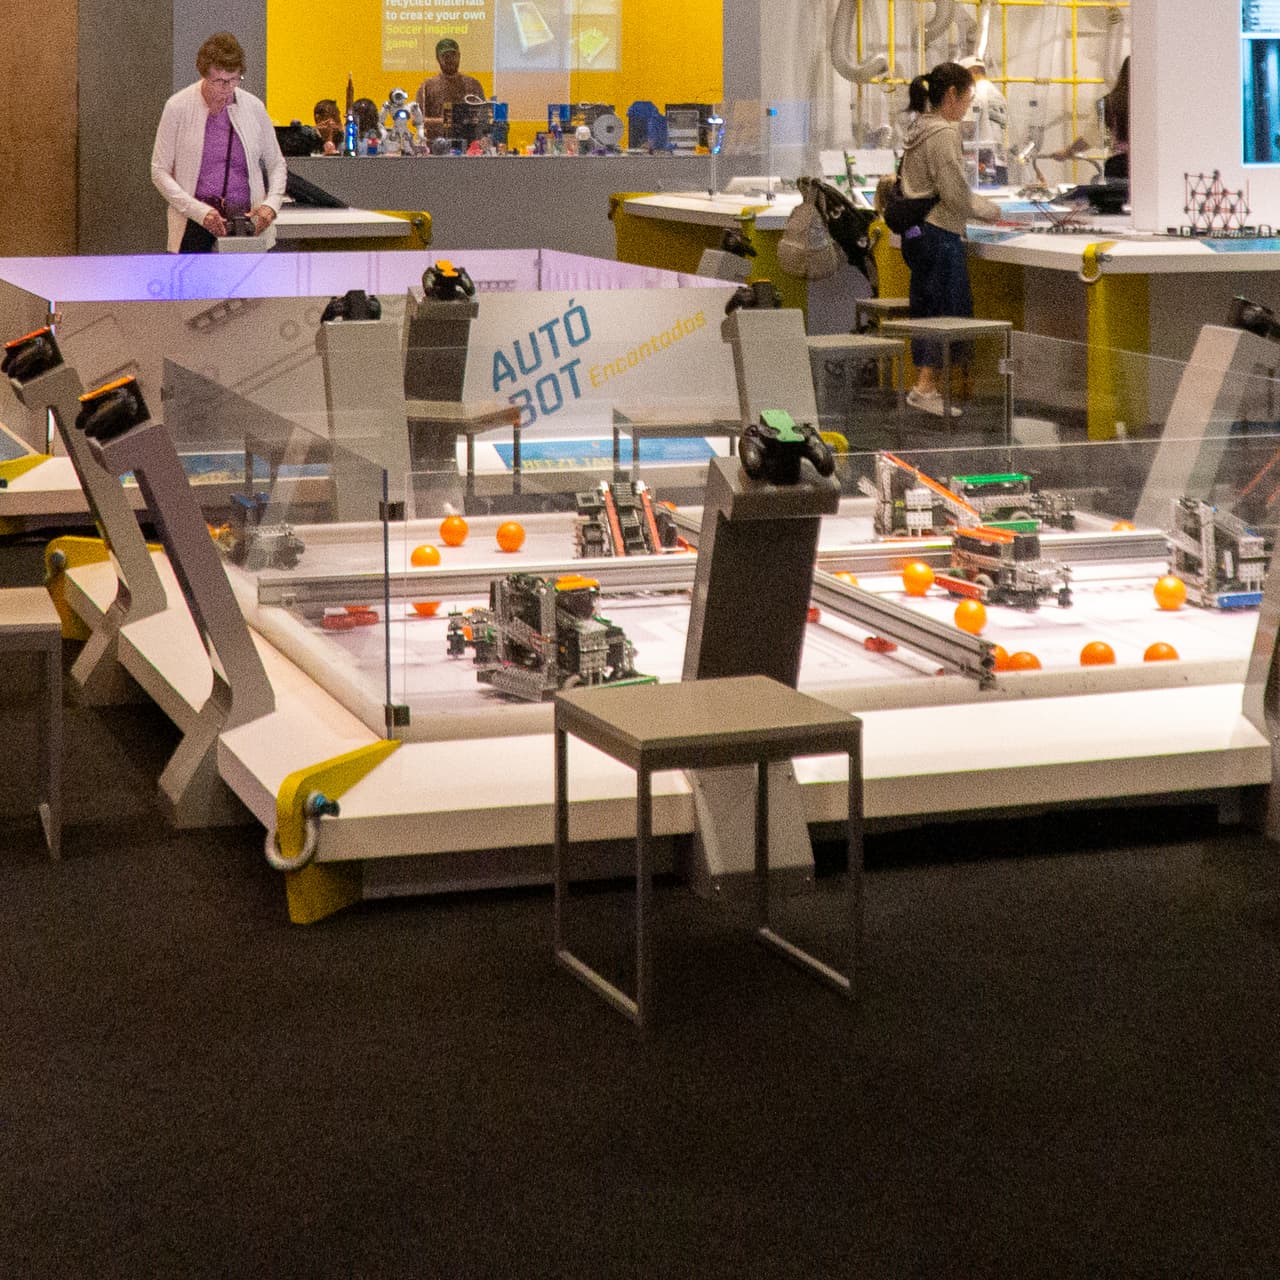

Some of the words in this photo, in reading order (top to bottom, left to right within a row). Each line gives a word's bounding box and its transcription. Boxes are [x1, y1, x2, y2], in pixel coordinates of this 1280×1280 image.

[386, 10, 398, 21] to
[400, 11, 433, 21] create
[435, 11, 461, 23] your
[463, 11, 486, 21] own
[386, 24, 423, 34] Soccer
[492, 298, 591, 393] AUTÓ
